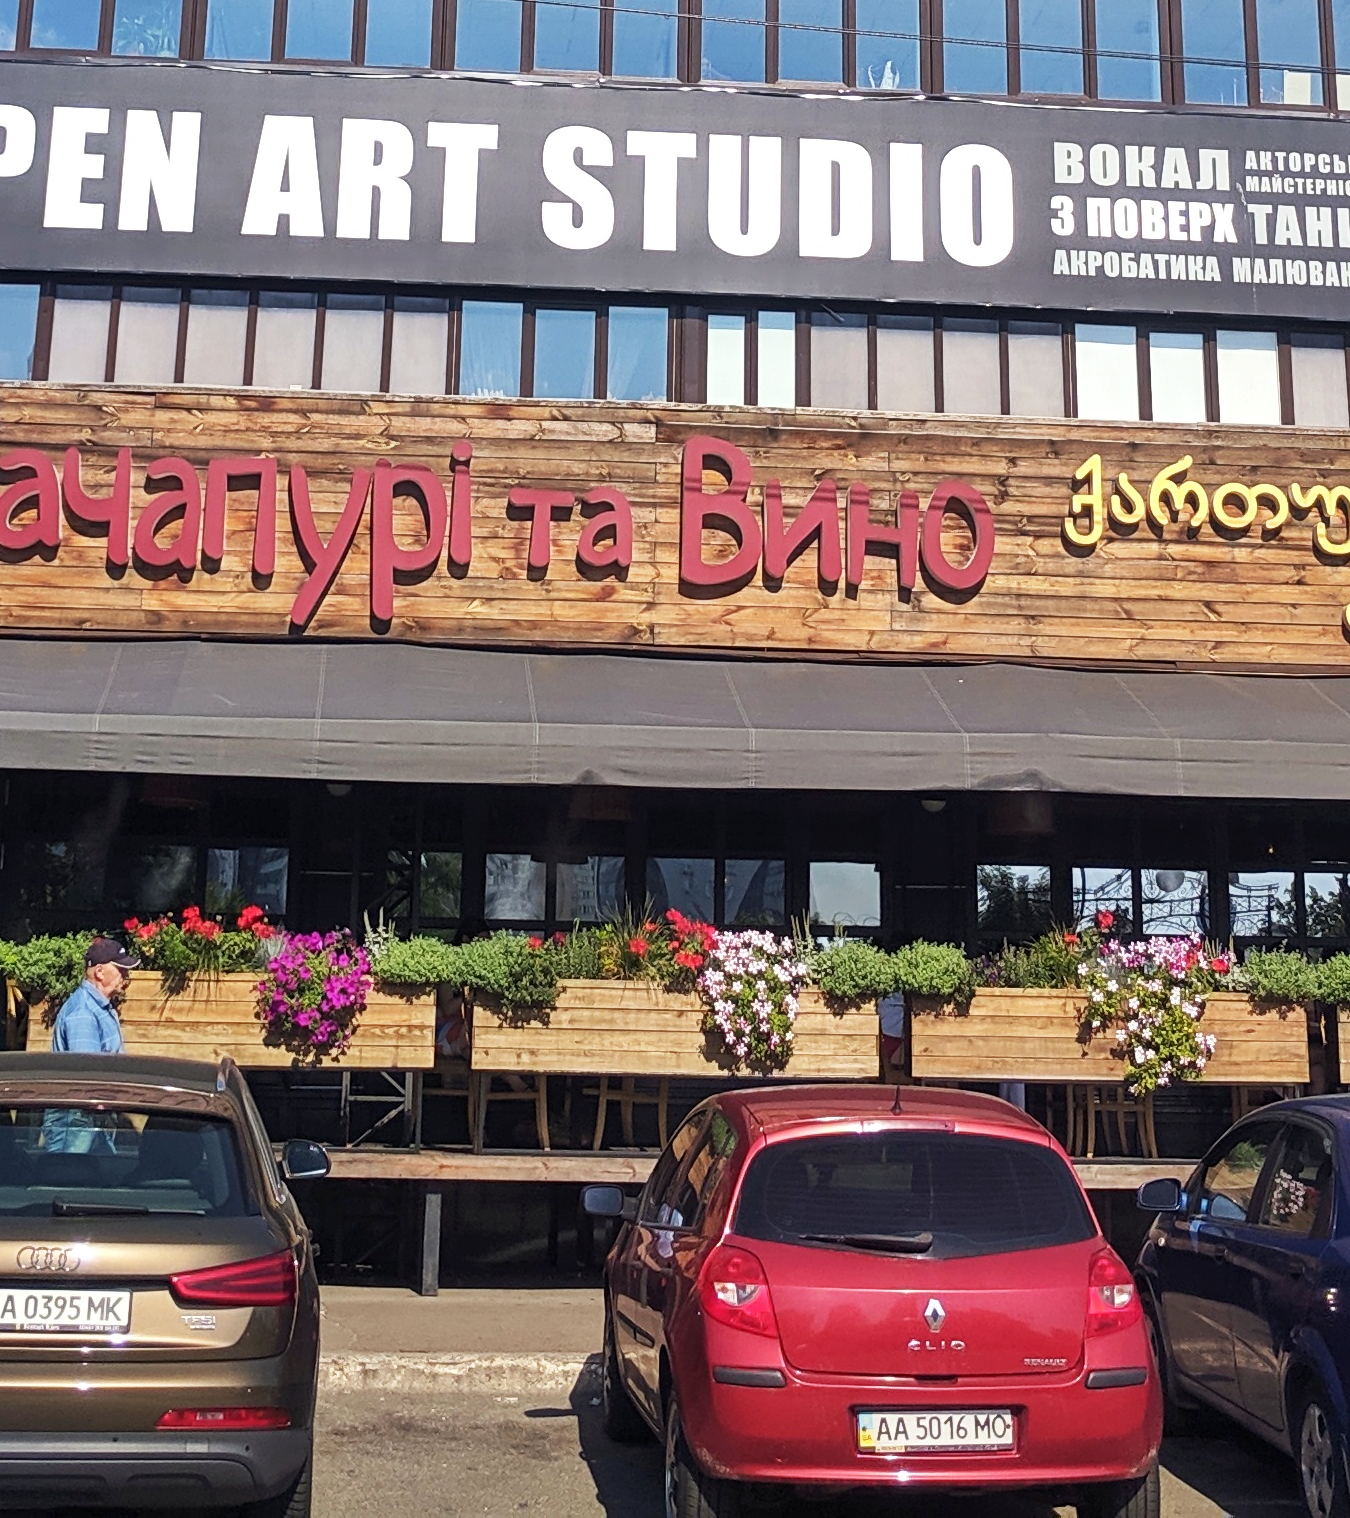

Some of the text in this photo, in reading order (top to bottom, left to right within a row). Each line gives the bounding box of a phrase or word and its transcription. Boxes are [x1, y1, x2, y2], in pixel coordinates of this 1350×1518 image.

[1053, 141, 1230, 191] ВОКАЛ
[240, 113, 500, 244] ART
[541, 124, 1015, 268] STUDIO
[1086, 196, 1238, 243] ПОВЕРХ
[1053, 249, 1222, 282] АКРОБАТИКА
[507, 487, 633, 568] та
[680, 435, 996, 589] Вино
[24, 1297, 81, 1321] 0395
[86, 1298, 123, 1322] MK
[908, 1339, 966, 1351] CLIO
[877, 1416, 909, 1441] AA
[916, 1415, 968, 1440] 5016
[974, 1413, 1007, 1439] MO
